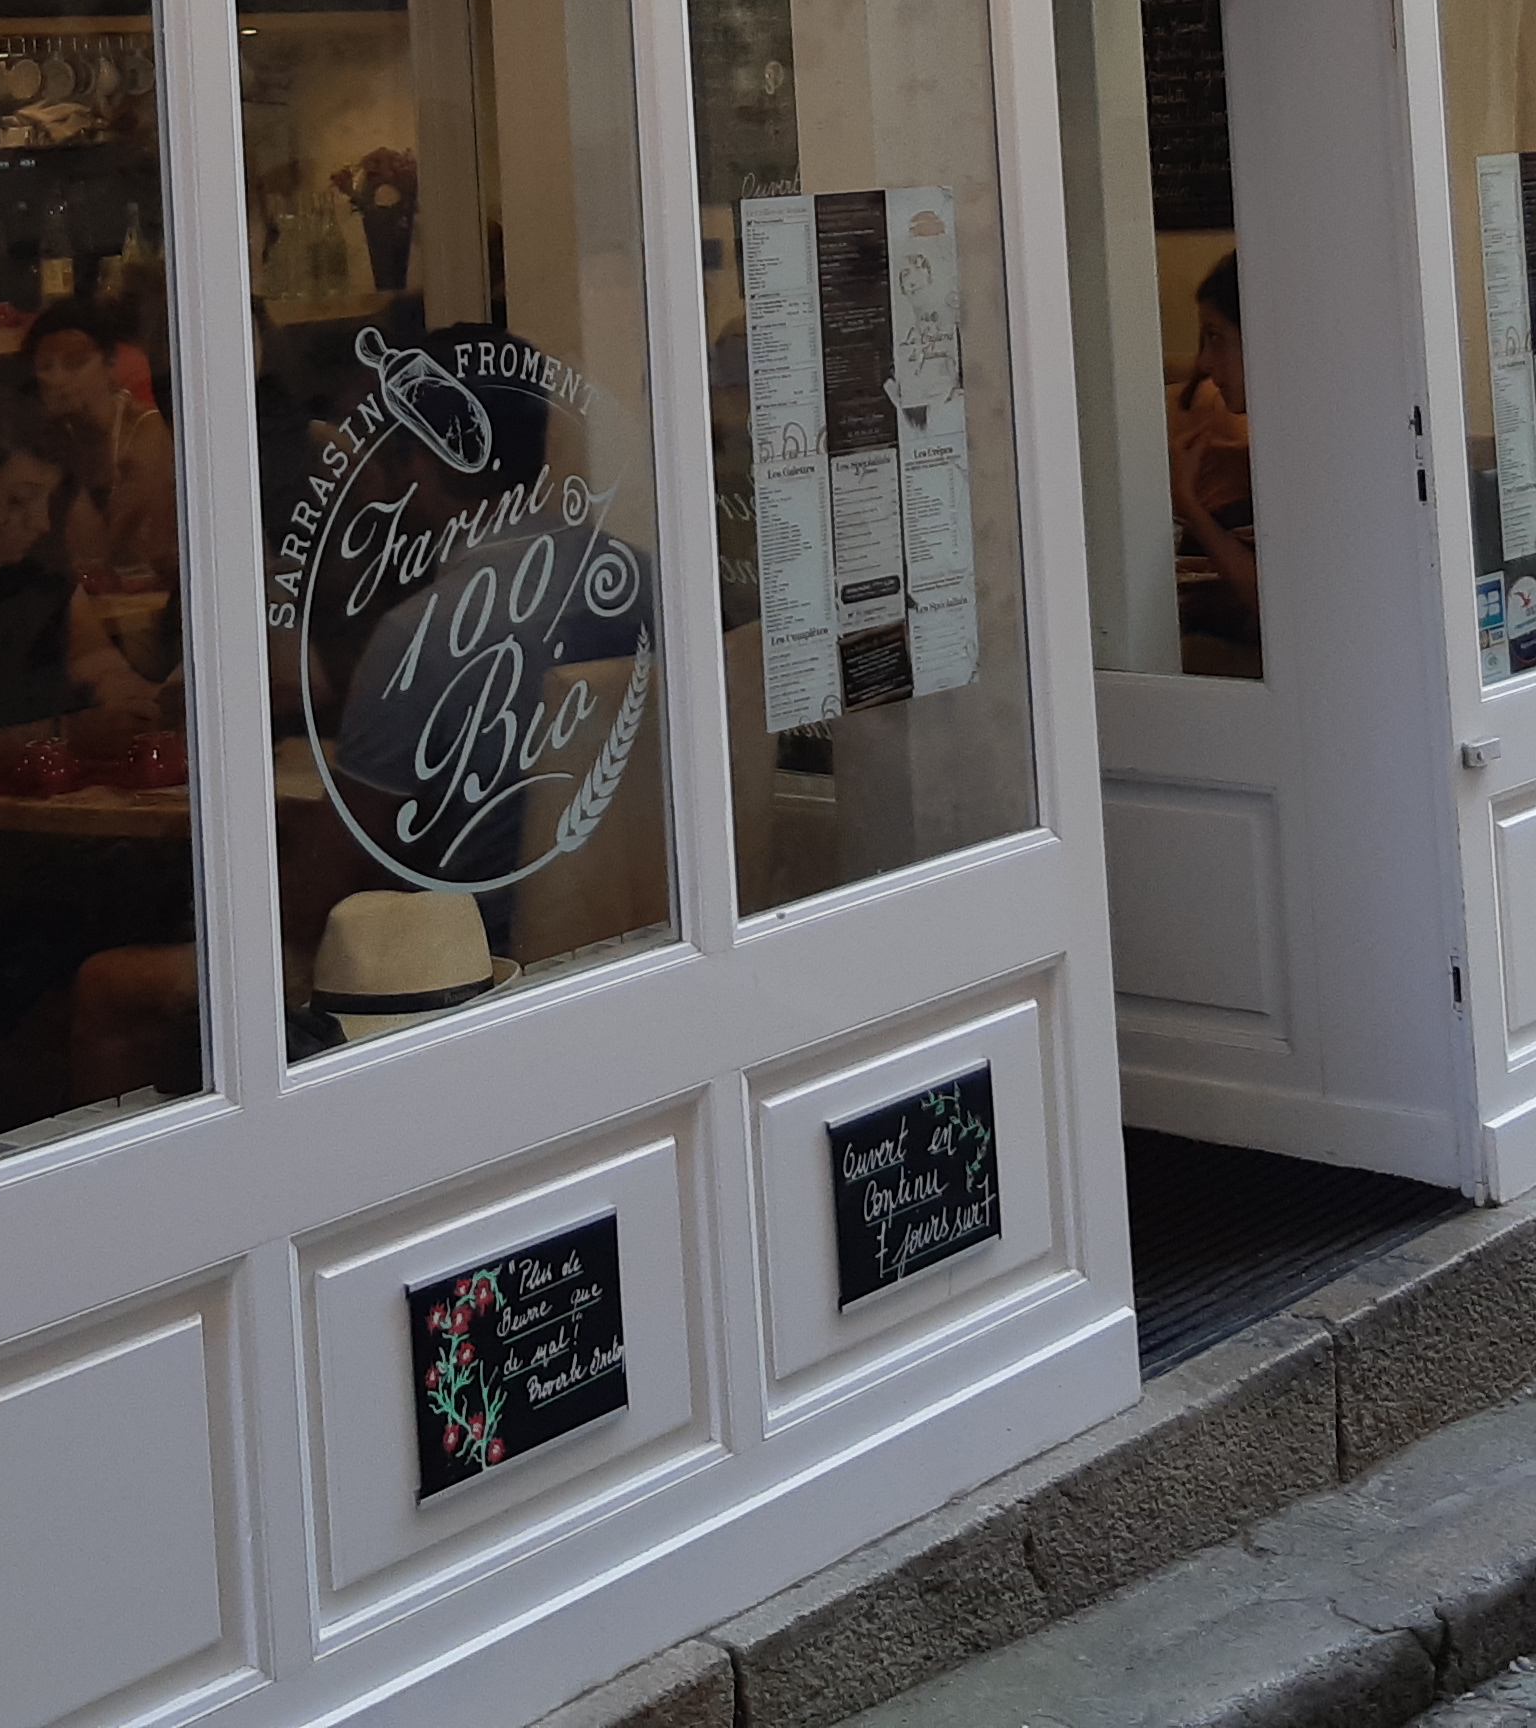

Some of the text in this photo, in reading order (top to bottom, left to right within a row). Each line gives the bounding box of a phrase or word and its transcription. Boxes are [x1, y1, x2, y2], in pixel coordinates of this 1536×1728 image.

[453, 342, 602, 417] FROMENT
[268, 392, 385, 629] SARRASIN
[341, 462, 554, 616] Farine
[396, 633, 597, 843] Bio
[843, 1115, 957, 1180] Ouvert en
[561, 1250, 583, 1276] de
[875, 1174, 996, 1282] 7 jours sur 7
[497, 1301, 553, 1338] Beurre
[503, 1348, 524, 1375] de
